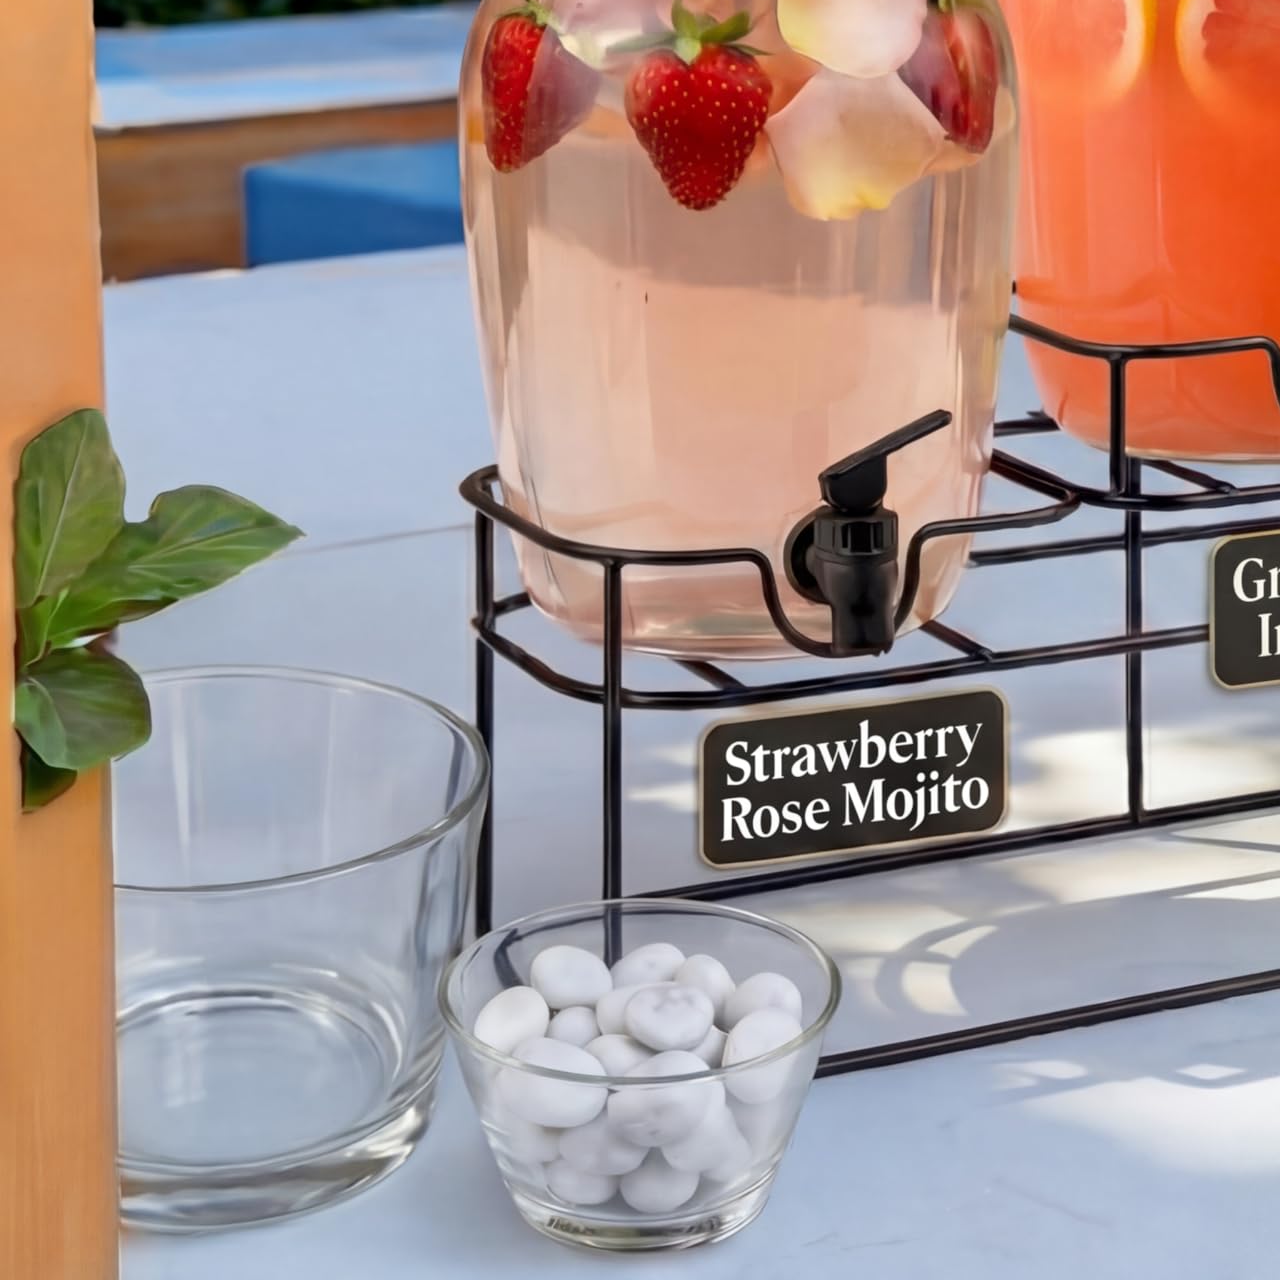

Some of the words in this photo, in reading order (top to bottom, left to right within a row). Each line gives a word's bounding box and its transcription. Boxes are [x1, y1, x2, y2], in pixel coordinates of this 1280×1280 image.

[724, 720, 983, 787] Strawberry
[720, 796, 831, 843] Rose
[841, 770, 990, 833] Mojito
